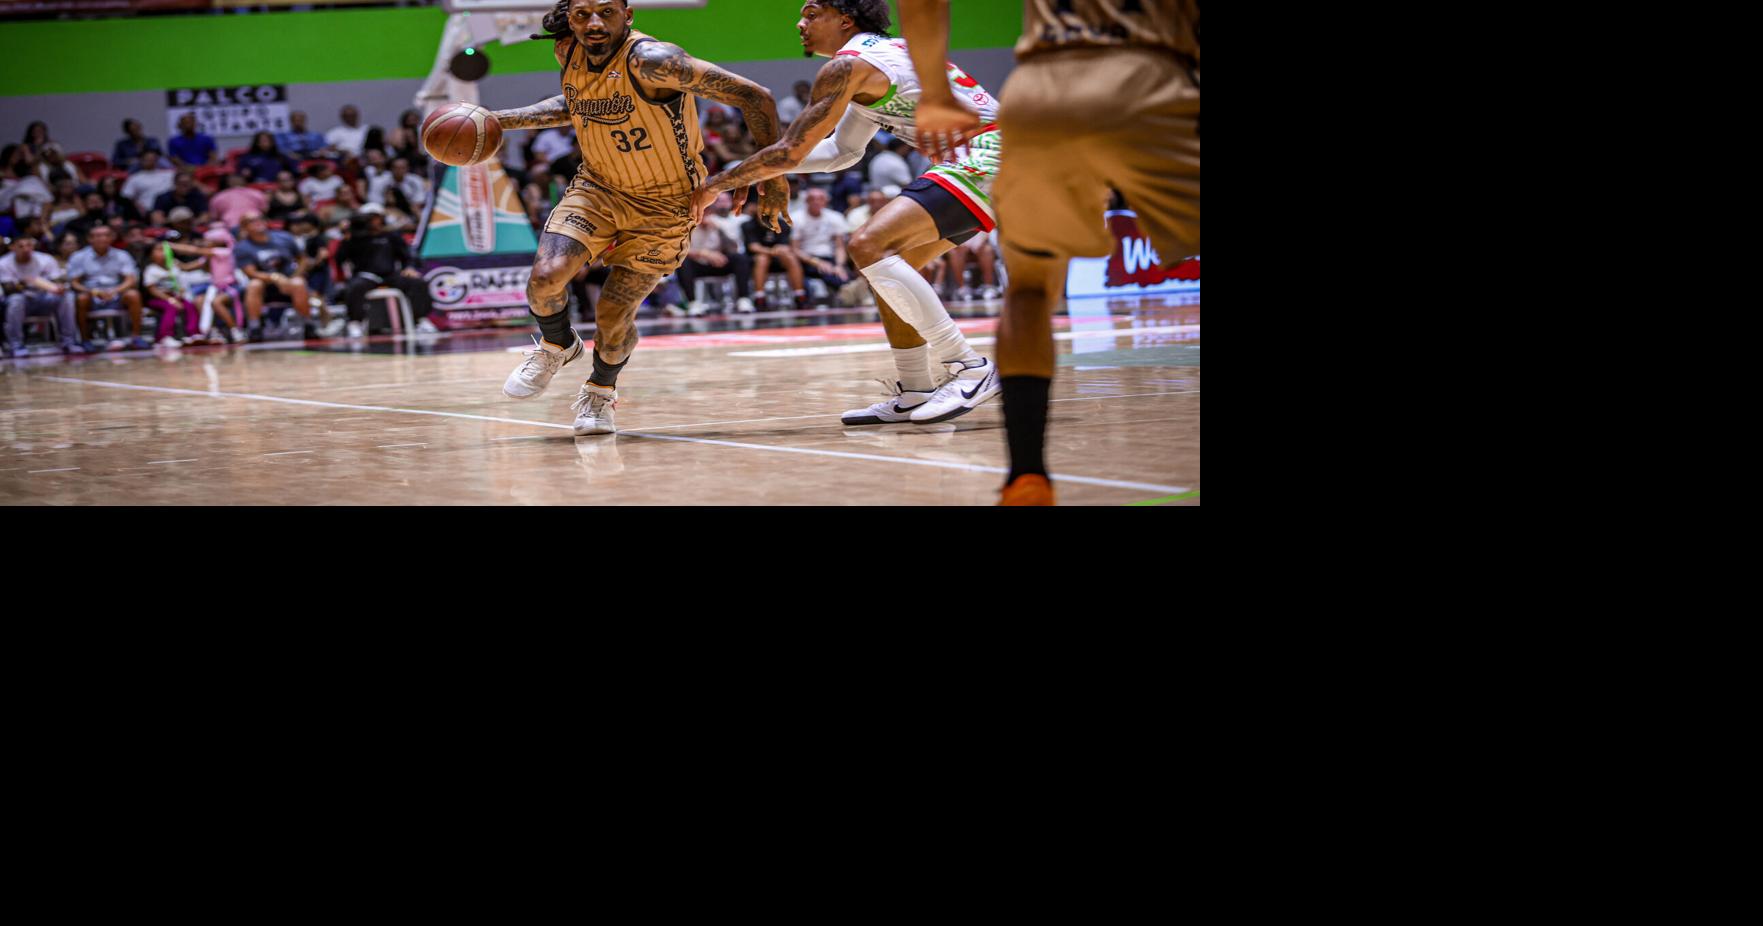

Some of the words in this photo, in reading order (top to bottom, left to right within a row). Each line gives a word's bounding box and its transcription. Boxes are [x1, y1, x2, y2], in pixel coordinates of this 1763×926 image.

[176, 85, 278, 104] PALCO
[564, 83, 635, 128] Bayamón
[610, 127, 653, 153] 32
[565, 216, 595, 236] Verdes
[567, 212, 598, 231] Lomas
